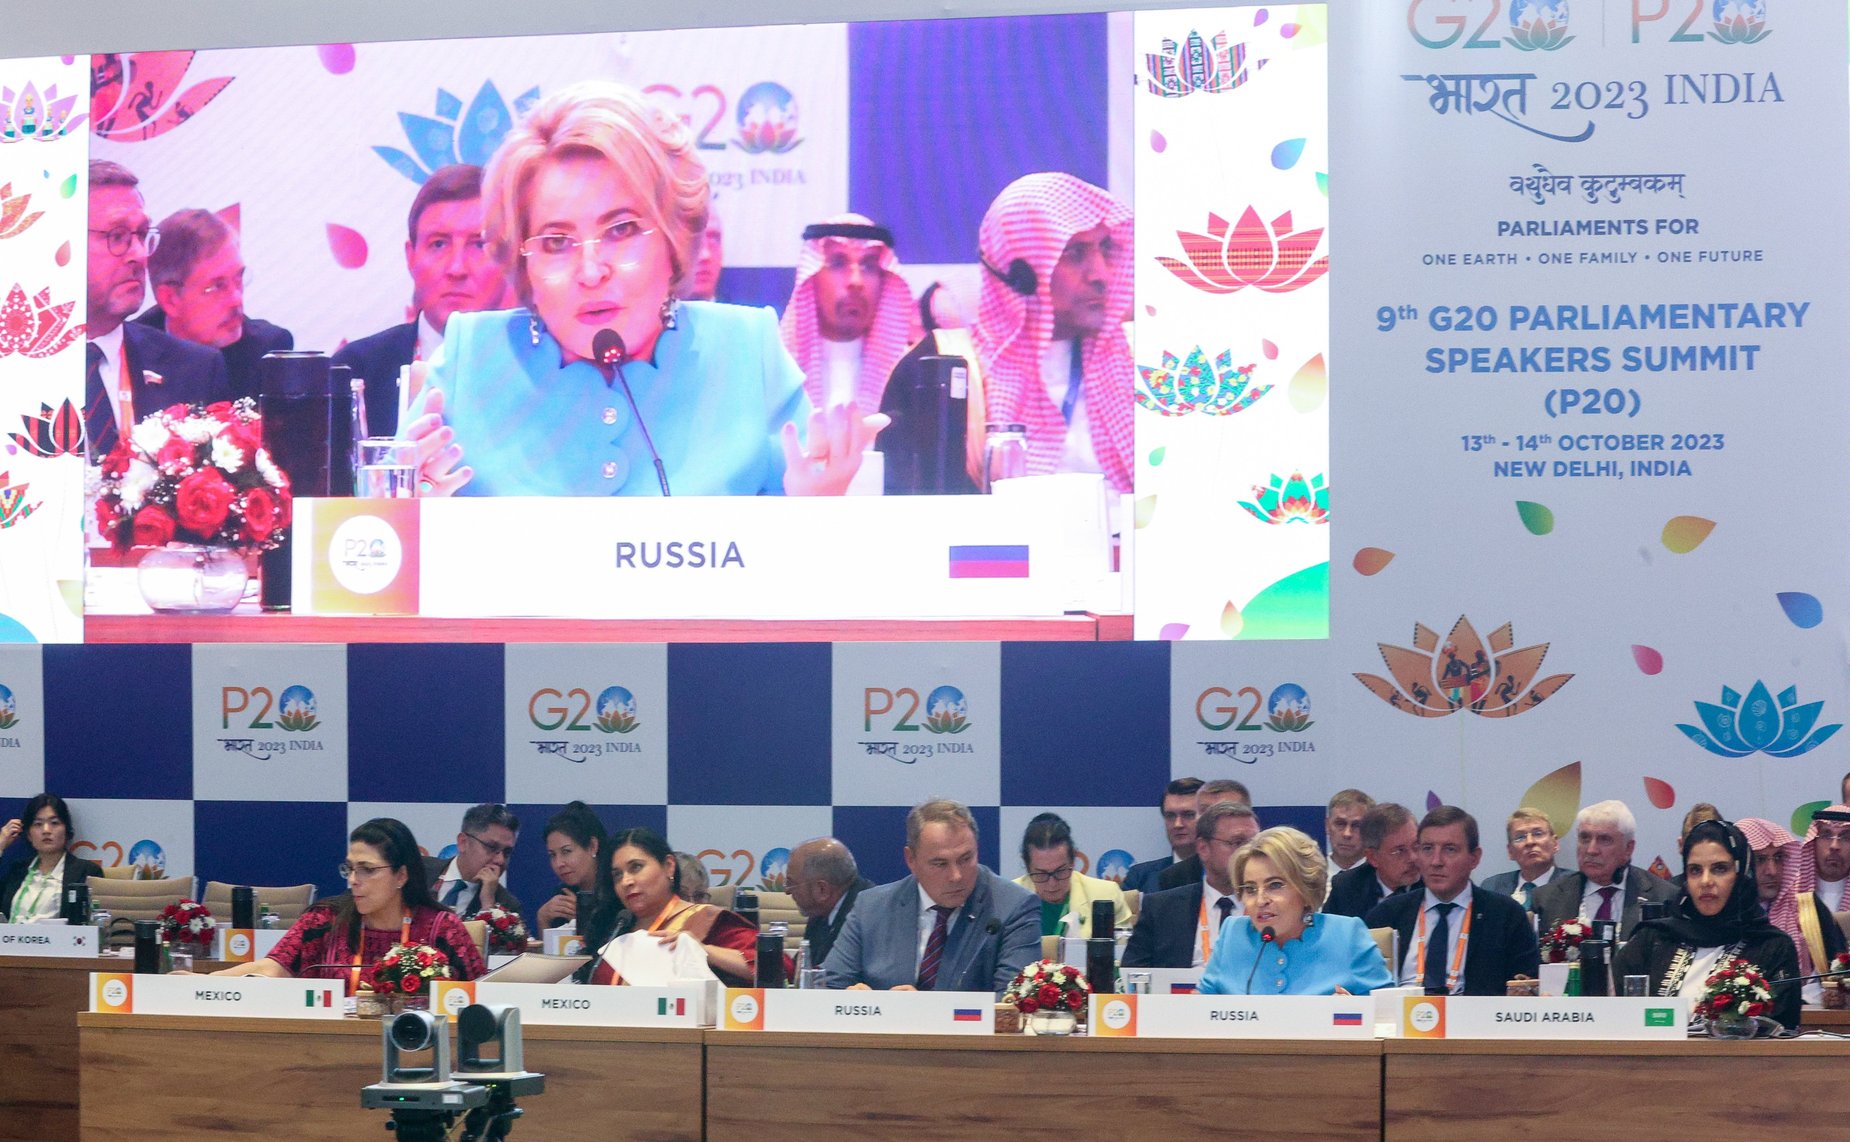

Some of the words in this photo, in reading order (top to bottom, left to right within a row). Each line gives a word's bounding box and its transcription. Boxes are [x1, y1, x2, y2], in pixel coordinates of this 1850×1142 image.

[1400, 73, 1595, 142] भारत
[1550, 80, 1649, 119] 2023
[1664, 72, 1784, 106] INDIA
[1497, 219, 1649, 237] PARLIAMENTS
[1655, 218, 1700, 235] FOR
[1422, 254, 1456, 266] ONE
[1463, 253, 1518, 265] EARTH
[1538, 252, 1573, 265] ONE
[1579, 251, 1638, 264] FAMILY
[1657, 250, 1692, 263] ONE
[1699, 249, 1764, 262] FUTURE
[1376, 305, 1418, 332] 9th
[1428, 305, 1498, 332] G20
[1510, 301, 1811, 331] PARLIAMENTARY
[1425, 346, 1612, 374] SPEAKERS
[1622, 344, 1761, 372] SUMMIT
[1544, 387, 1642, 419] (P20)
[1461, 434, 1496, 452] 13th
[1516, 434, 1552, 452] 14th
[1557, 433, 1664, 452] OCTOBER
[1671, 432, 1725, 450] 2023
[1494, 460, 1546, 478] NEW
[1553, 460, 1624, 480] DELHI,
[1630, 459, 1692, 477] INDIA
[615, 540, 746, 570] RUSSIA
[222, 685, 322, 732] P20
[528, 685, 641, 734] G20
[864, 685, 973, 735] P20
[1195, 682, 1316, 733] G20
[257, 741, 286, 754] 2023
[289, 740, 324, 751] INDIA
[572, 743, 602, 756] 2023
[605, 742, 642, 753] INDIA
[902, 744, 933, 757] 2023
[937, 742, 974, 754] INDIA
[1242, 744, 1274, 757] 2023
[1277, 741, 1316, 753] INDIA
[2, 935, 16, 944] OF
[18, 935, 51, 945] KOREA
[194, 990, 242, 1002] MEXICO
[541, 999, 591, 1010] MEXICO
[835, 1005, 882, 1016] RUSSIA
[1210, 1010, 1259, 1021] RUSSIA
[1495, 1012, 1537, 1023] SAUDI
[1541, 1012, 1595, 1023] ARABIA
